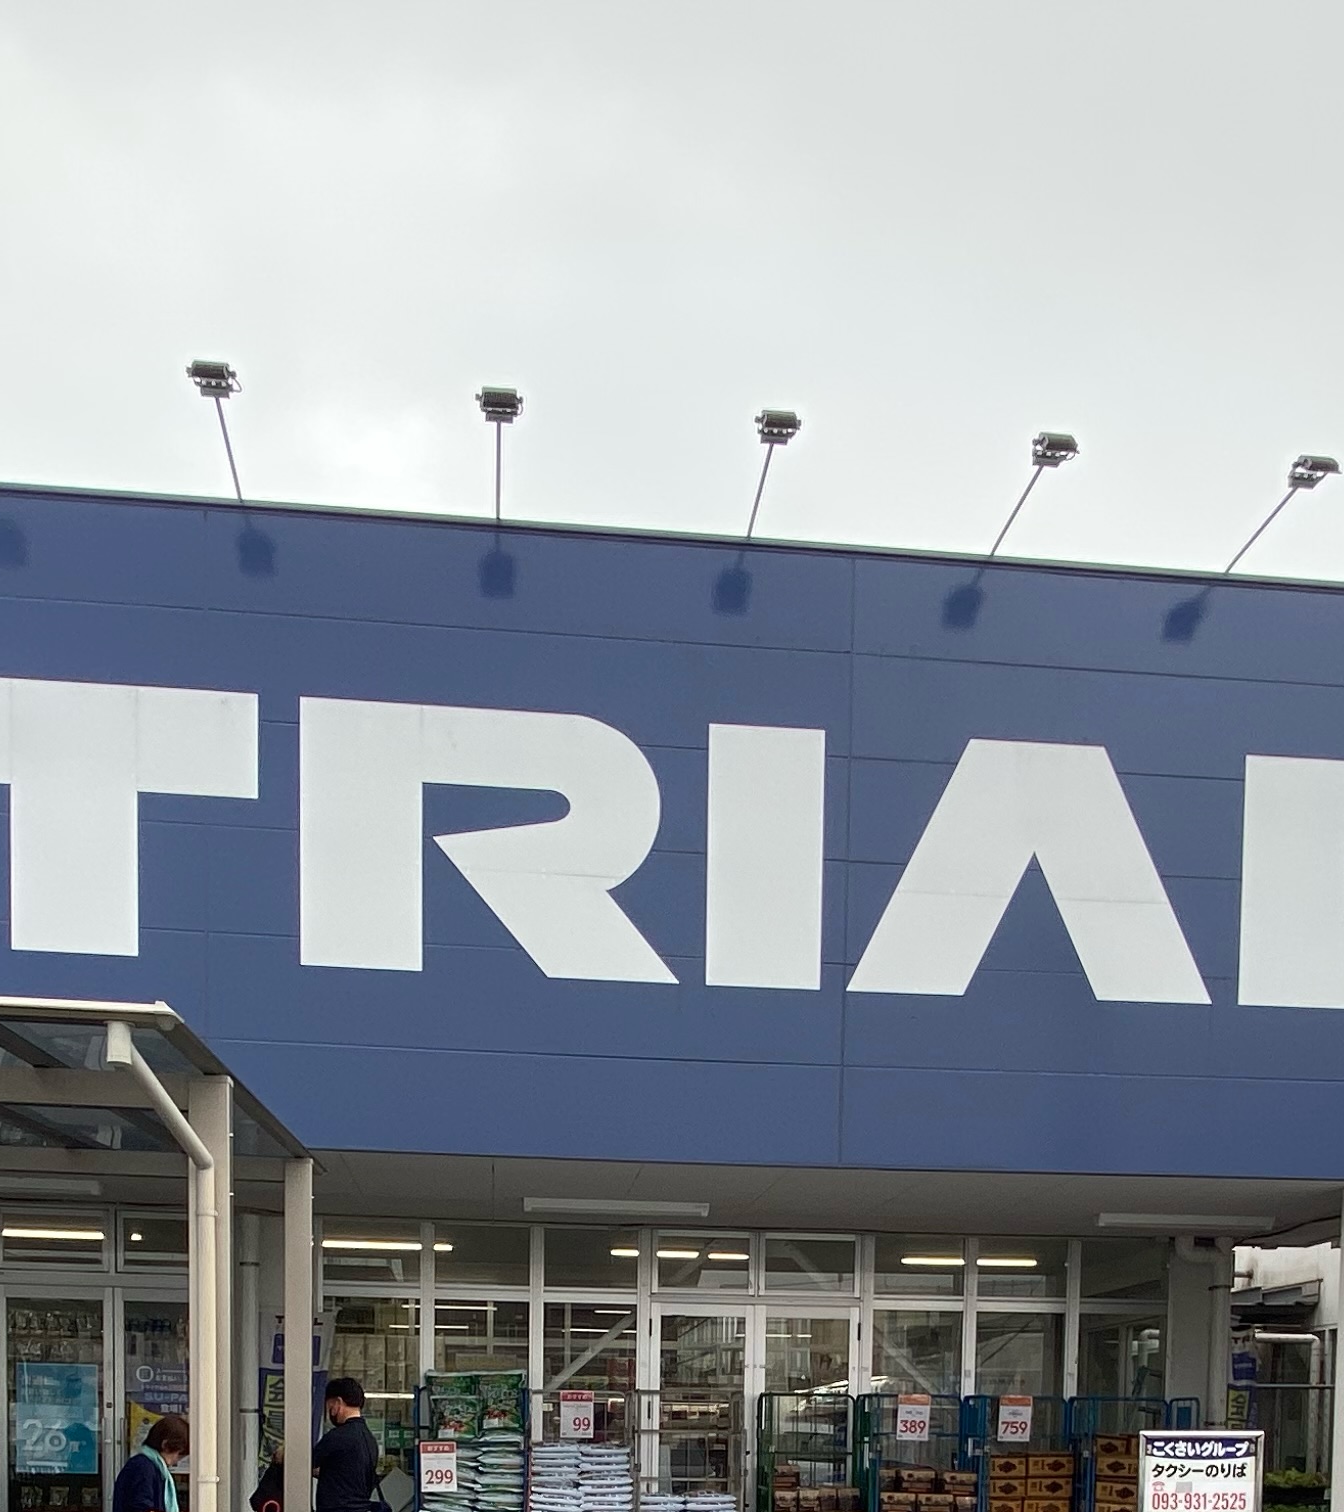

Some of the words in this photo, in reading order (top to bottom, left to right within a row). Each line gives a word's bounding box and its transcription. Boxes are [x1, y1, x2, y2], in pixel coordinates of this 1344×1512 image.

[144, 1392, 188, 1402] SU-PA
[572, 1416, 591, 1432] 99
[899, 1419, 927, 1434] 389
[1000, 1420, 1028, 1435] 759
[1152, 1441, 1250, 1457] こくさいグループ
[425, 1469, 454, 1485] 299
[1151, 1463, 1248, 1479] タクシーのりば
[1151, 1492, 1247, 1511] 093-931-2525
